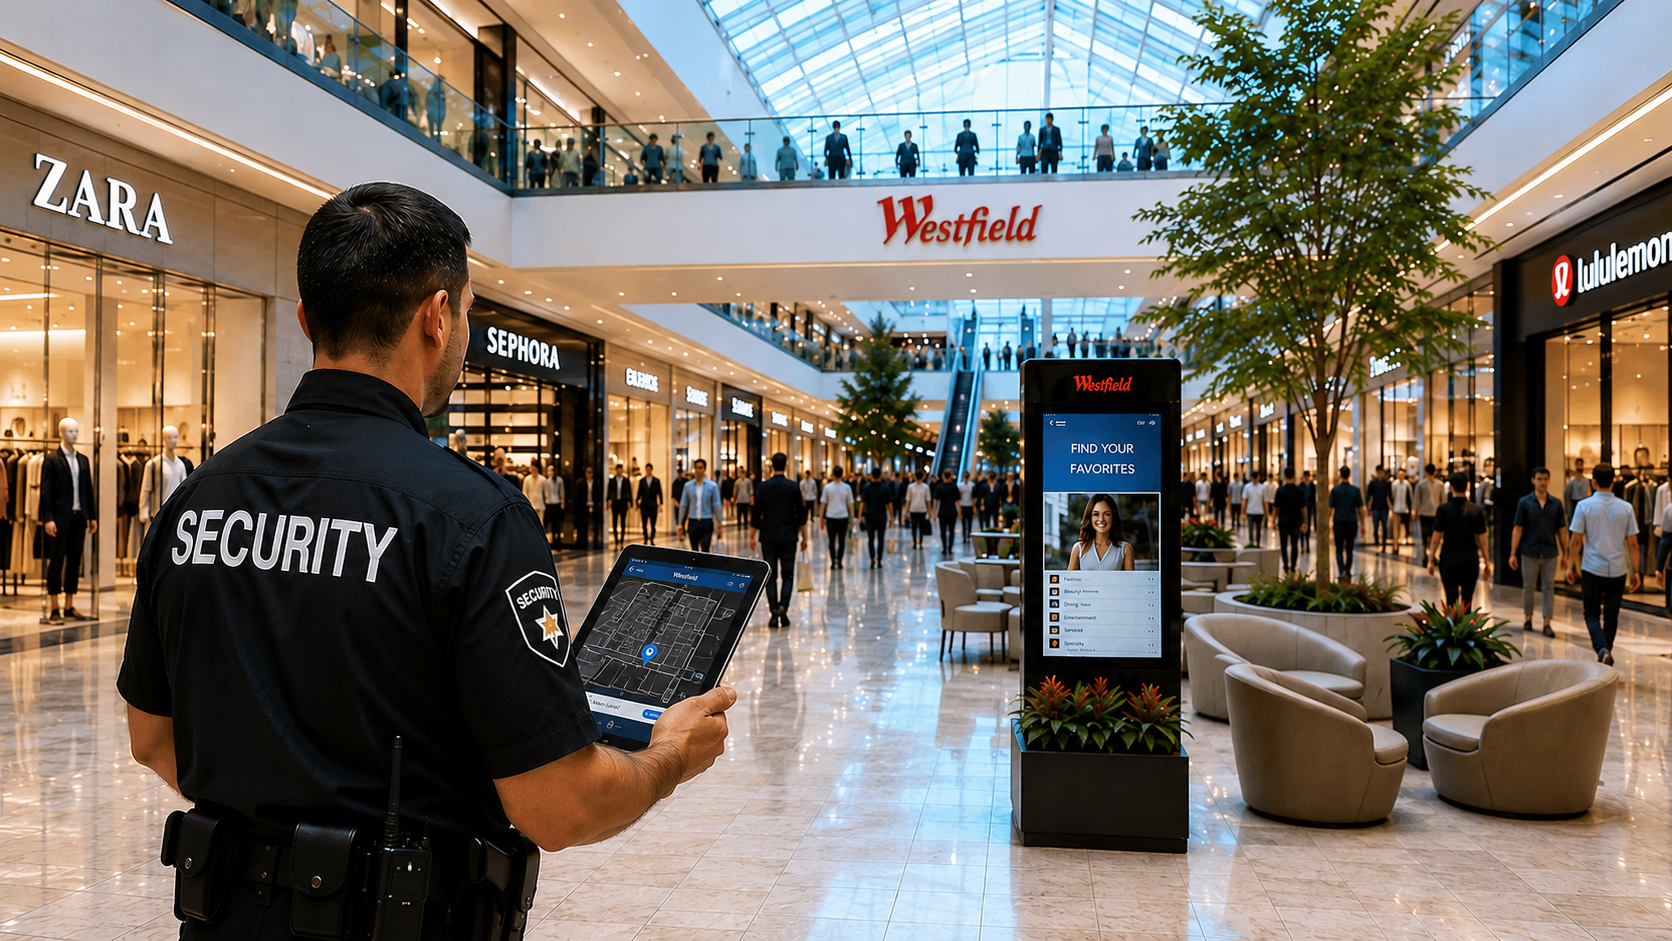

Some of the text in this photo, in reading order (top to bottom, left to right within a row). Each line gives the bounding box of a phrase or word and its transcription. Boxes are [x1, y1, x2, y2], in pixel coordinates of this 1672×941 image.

[32, 153, 174, 245] ZARA
[877, 194, 1043, 247] Westfield
[1577, 231, 1672, 294] lululemon
[486, 326, 560, 370] SEPHORA
[1073, 374, 1133, 393] Westfield
[1070, 443, 1134, 454] FIND YOUR
[1070, 463, 1135, 475] FAVORITES
[171, 509, 398, 583] SECURITY
[516, 586, 559, 610] SECURITY
